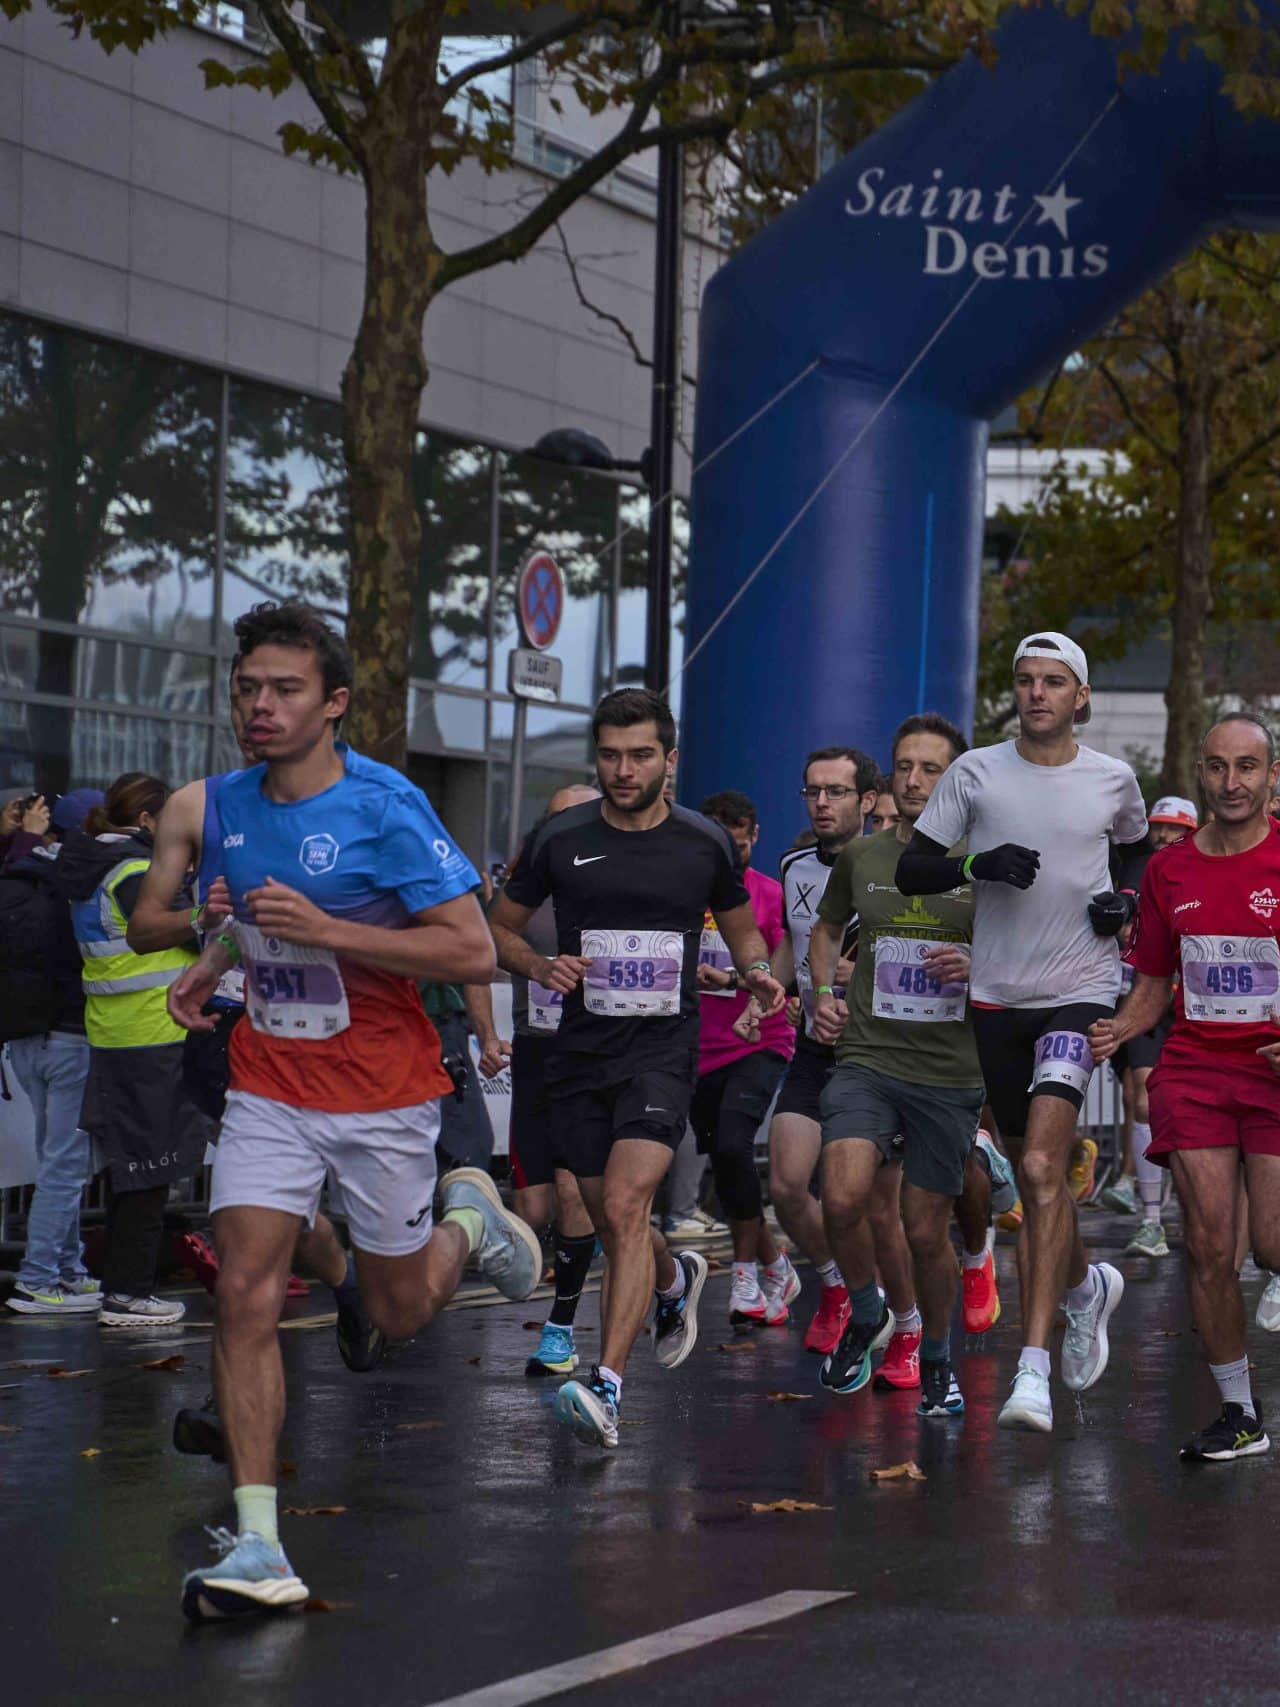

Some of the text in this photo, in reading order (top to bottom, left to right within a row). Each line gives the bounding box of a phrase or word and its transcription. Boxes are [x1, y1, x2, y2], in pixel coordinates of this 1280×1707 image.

[844, 166, 1017, 225] Saint
[922, 224, 1110, 279] Denis
[254, 964, 307, 1000] 547
[608, 960, 656, 989] 538
[1206, 965, 1254, 994] 496
[1041, 1034, 1084, 1062] 203
